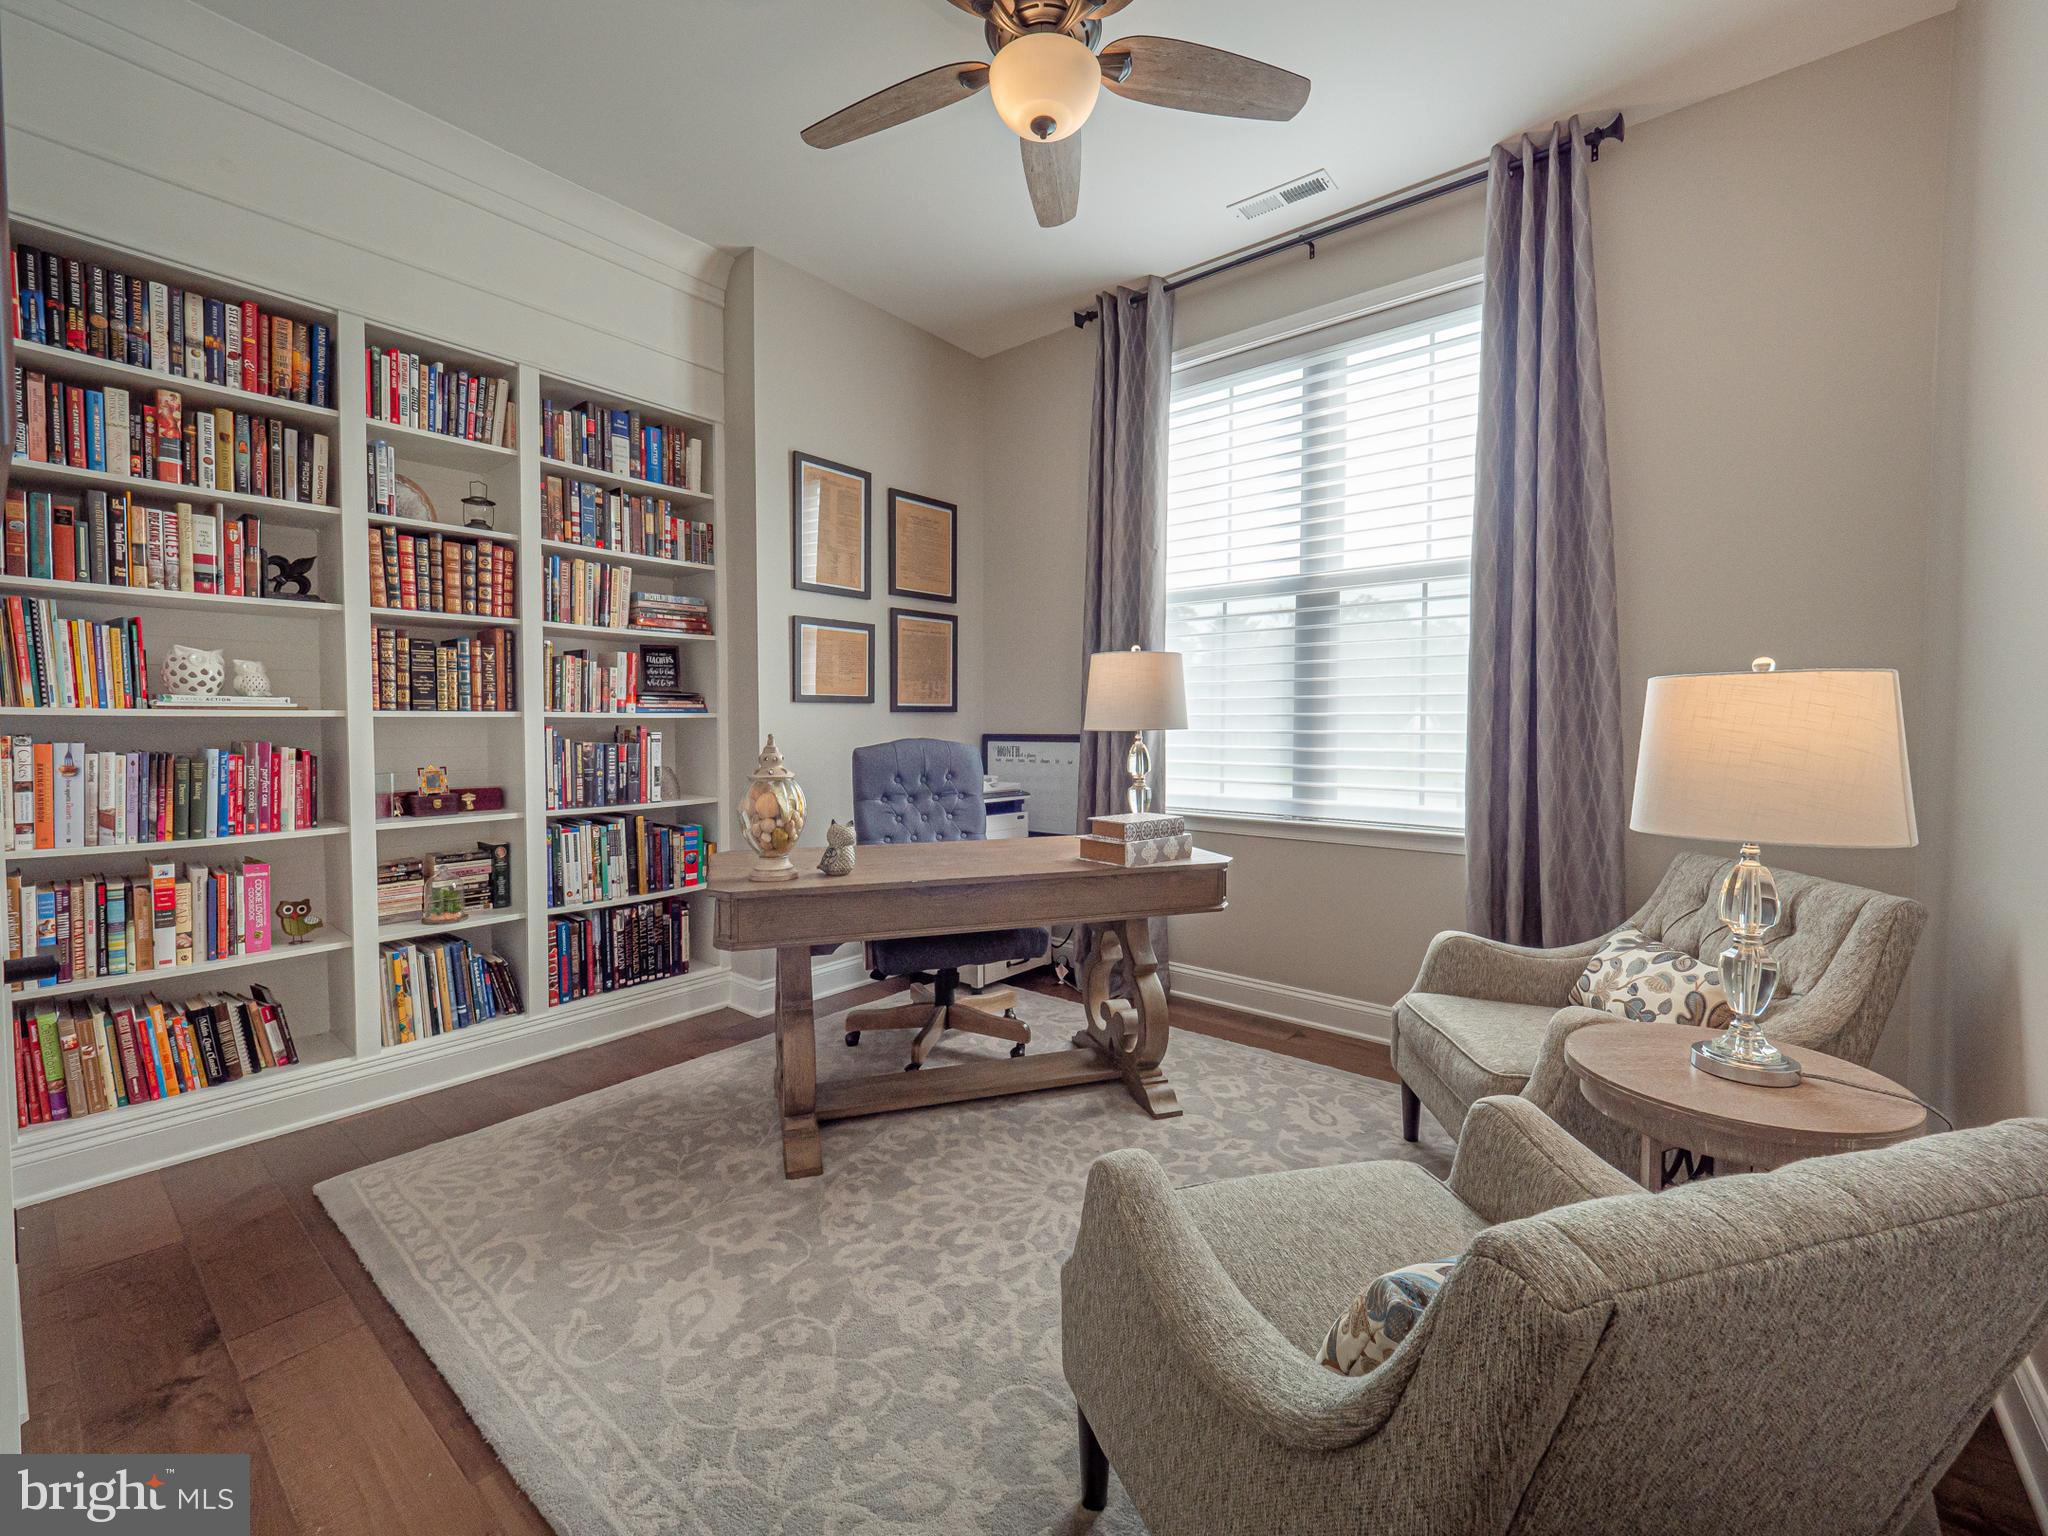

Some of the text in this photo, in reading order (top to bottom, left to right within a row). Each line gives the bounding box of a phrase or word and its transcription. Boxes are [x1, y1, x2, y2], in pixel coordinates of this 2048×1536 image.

[50, 257, 59, 299] STEVE BERRY
[70, 261, 80, 306] STEVE BERRY
[94, 268, 103, 314] STEVE BERRY
[114, 274, 124, 320] STEVE BERRY
[133, 280, 142, 323] STEVE BERRY
[154, 285, 166, 334] STEVE BERRY
[229, 308, 240, 353] STEVE BERRY
[318, 346, 326, 374] BROWN
[204, 436, 213, 456] TEMPLAR
[302, 461, 310, 494] PRODIGY
[96, 510, 105, 546] GODFATHER
[148, 512, 160, 561] BREAKING POINT
[165, 515, 179, 550] ARTICLE
[18, 750, 30, 780] Cakes
[996, 746, 1020, 758] MONTH
[220, 784, 228, 796] Bible
[248, 766, 258, 814] perfect cookie
[260, 768, 270, 792] perfect
[178, 888, 188, 925] BREAD
[654, 916, 664, 944] WAR
[548, 929, 560, 993] HISTORY
[42, 1023, 57, 1076] Celebrations
[118, 1015, 139, 1079] GREAT MEAT COOKBOOK
[199, 1018, 220, 1076] Main Line Classics
